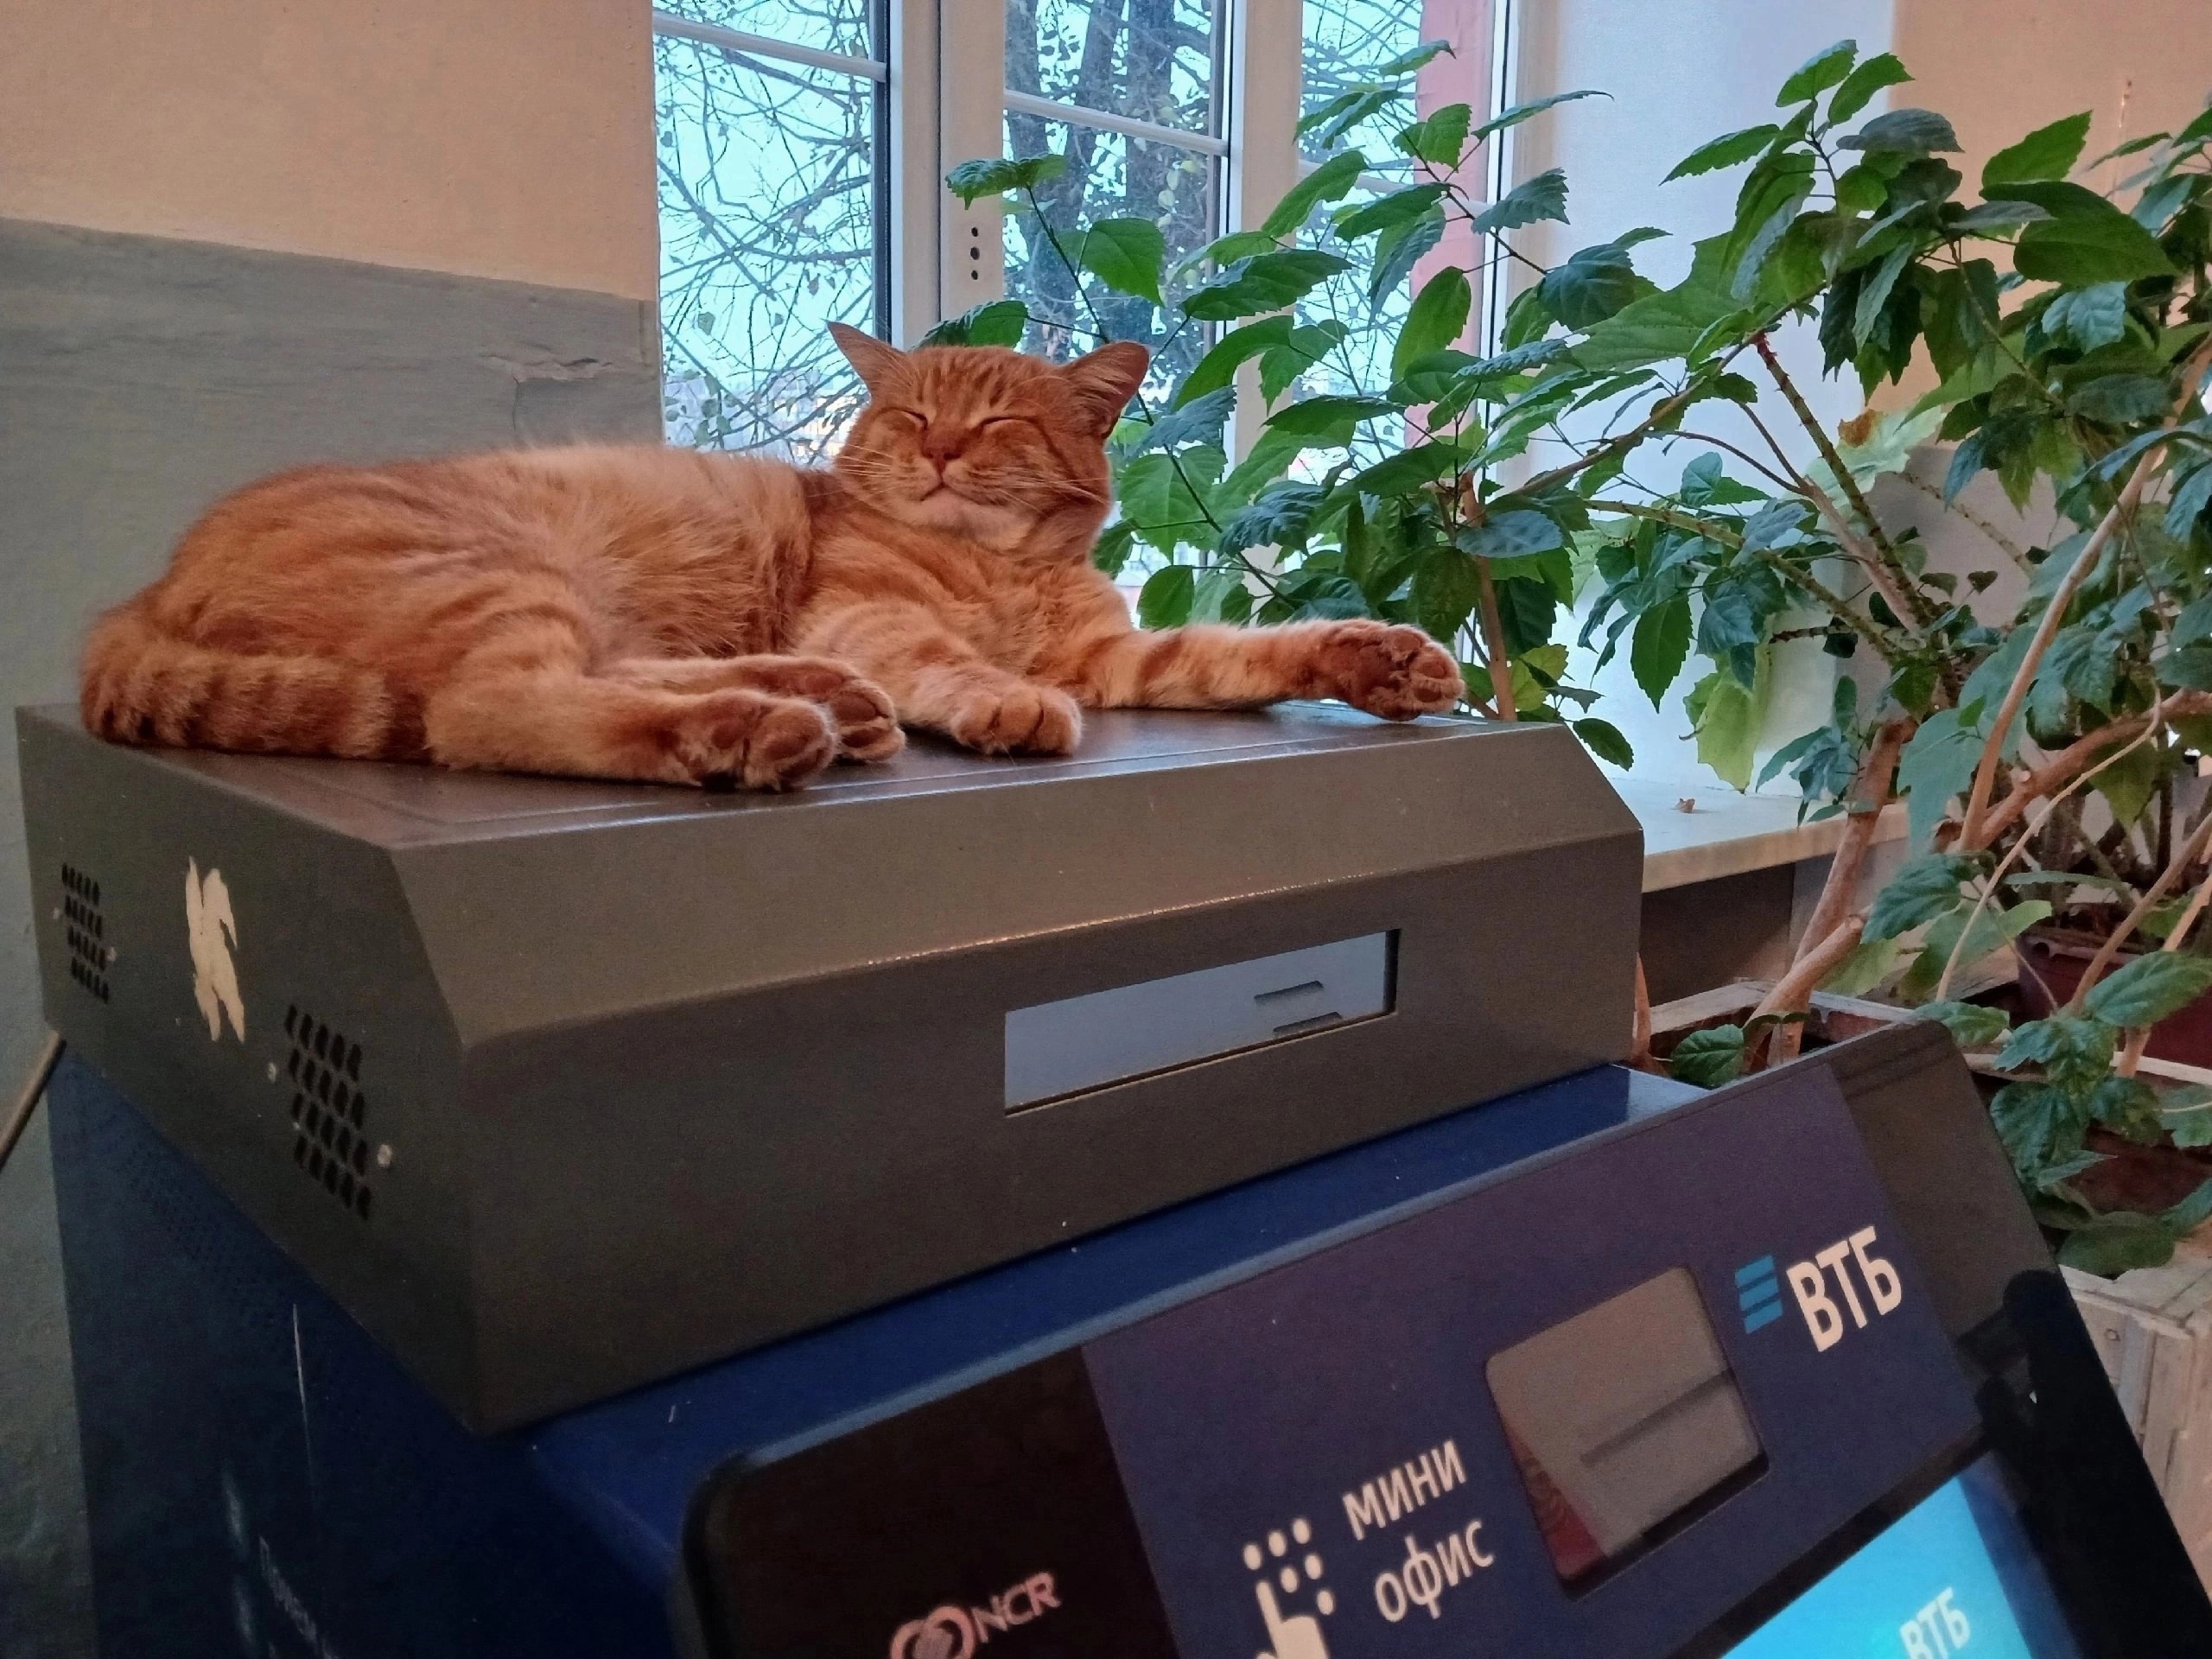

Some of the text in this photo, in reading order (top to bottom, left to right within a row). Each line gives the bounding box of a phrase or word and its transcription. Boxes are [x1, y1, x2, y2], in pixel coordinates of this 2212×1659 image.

[1785, 1225, 1902, 1352] ВТБ
[970, 1572, 1061, 1643] NCR
[1899, 1586, 1971, 1659] ВТБ
